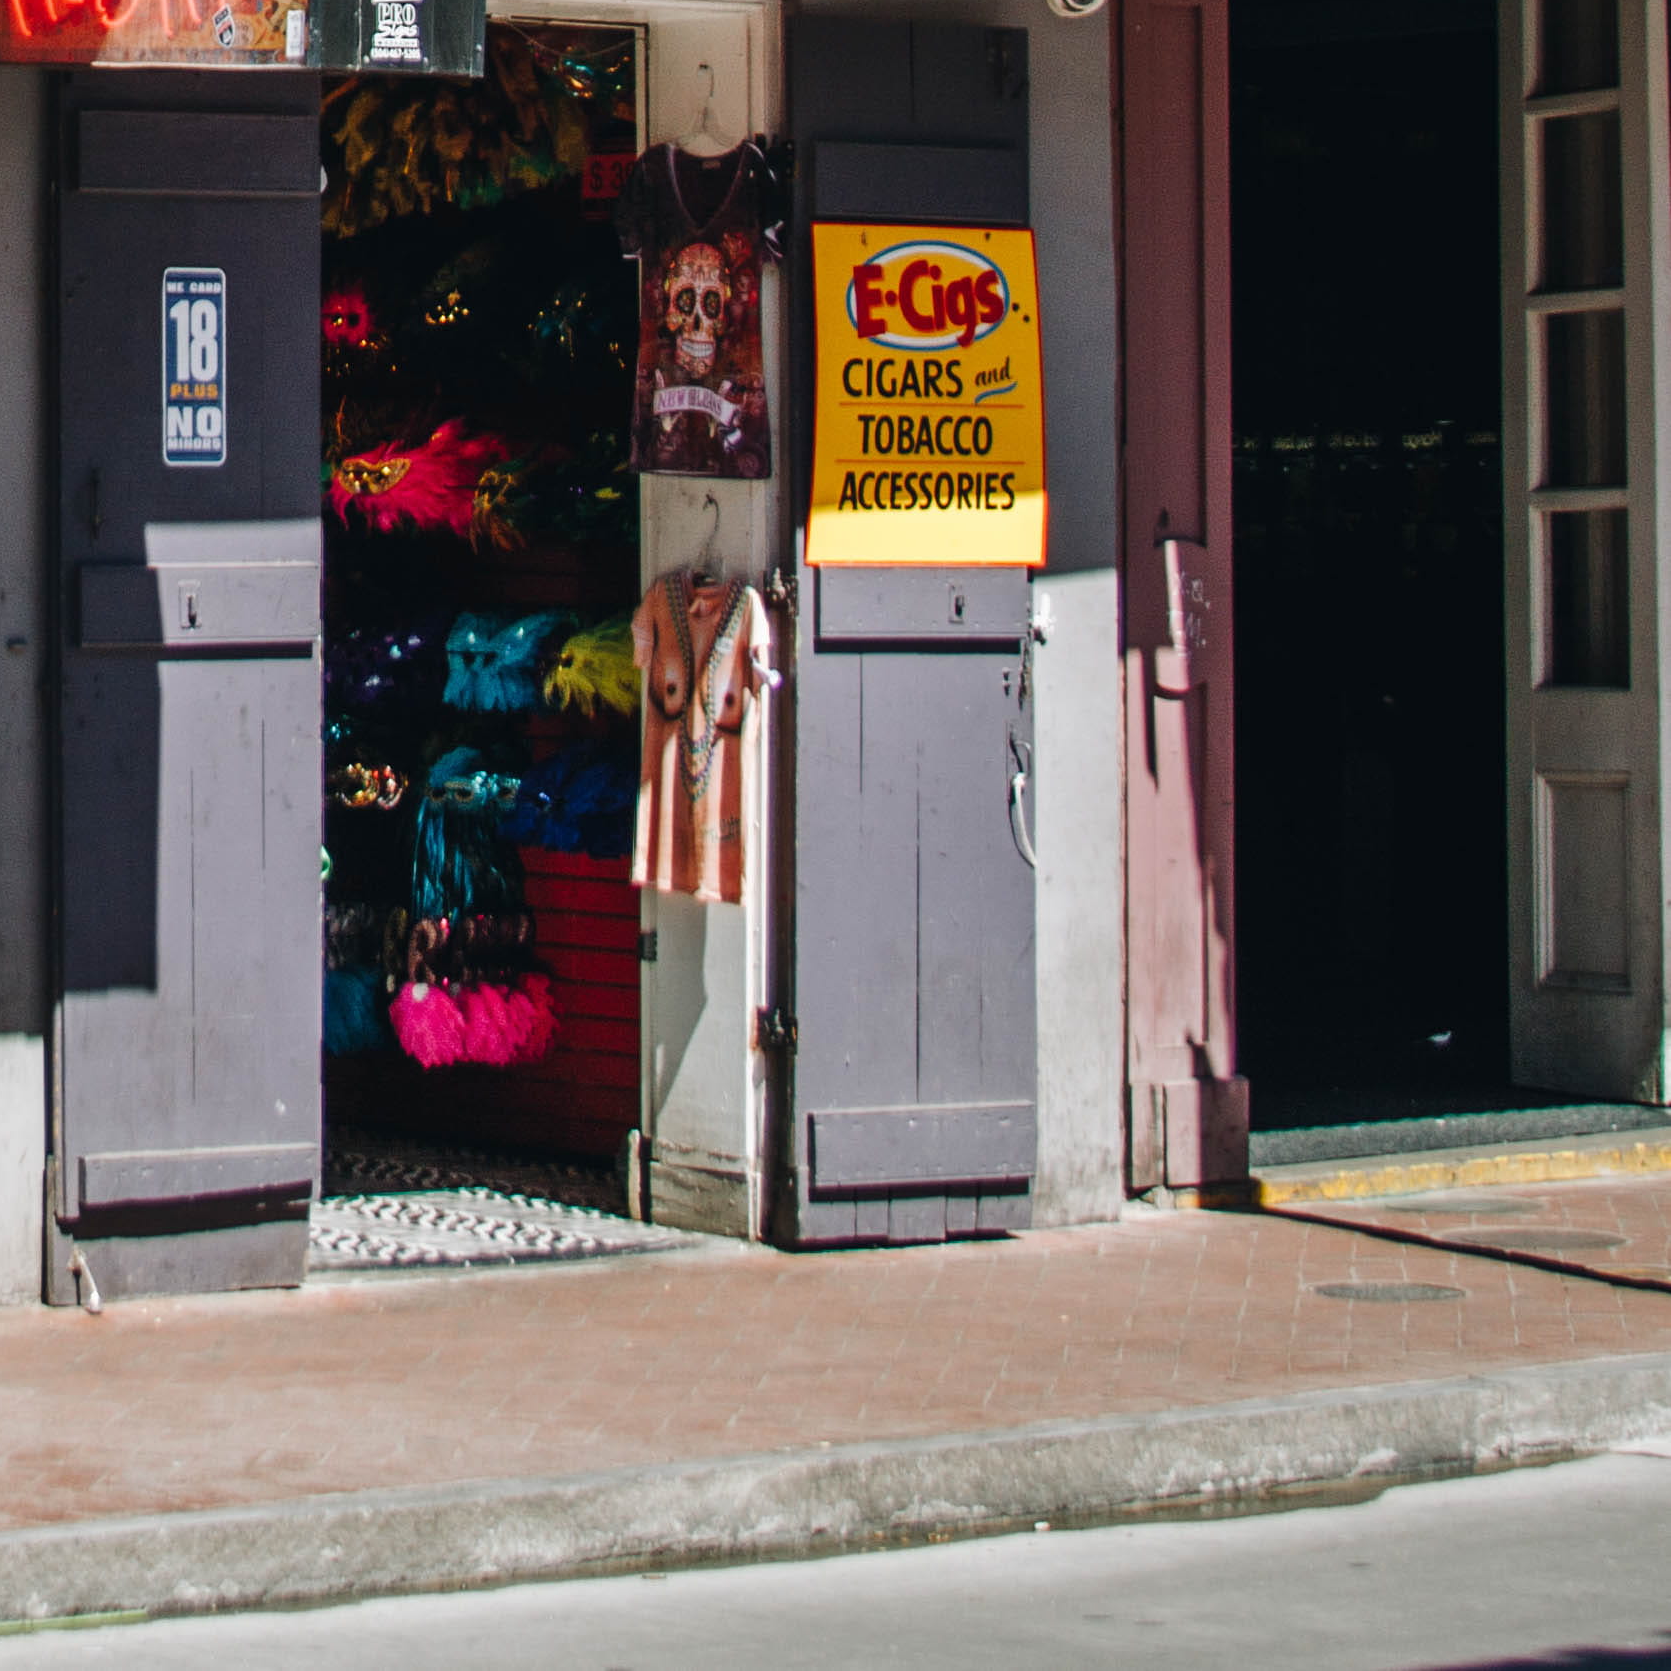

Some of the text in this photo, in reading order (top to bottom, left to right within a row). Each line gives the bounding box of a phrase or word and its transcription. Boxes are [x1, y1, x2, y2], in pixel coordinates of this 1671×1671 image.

[377, 3, 416, 26] PRO
[166, 281, 222, 294] WE CARD
[170, 299, 218, 382] 18
[170, 384, 218, 399] PLUS
[842, 357, 1012, 398] CIGARS and
[166, 406, 222, 437] NO
[858, 414, 993, 456] TOBACCO
[166, 437, 222, 452] MINORS
[838, 471, 1016, 511] ACCESSORIES
